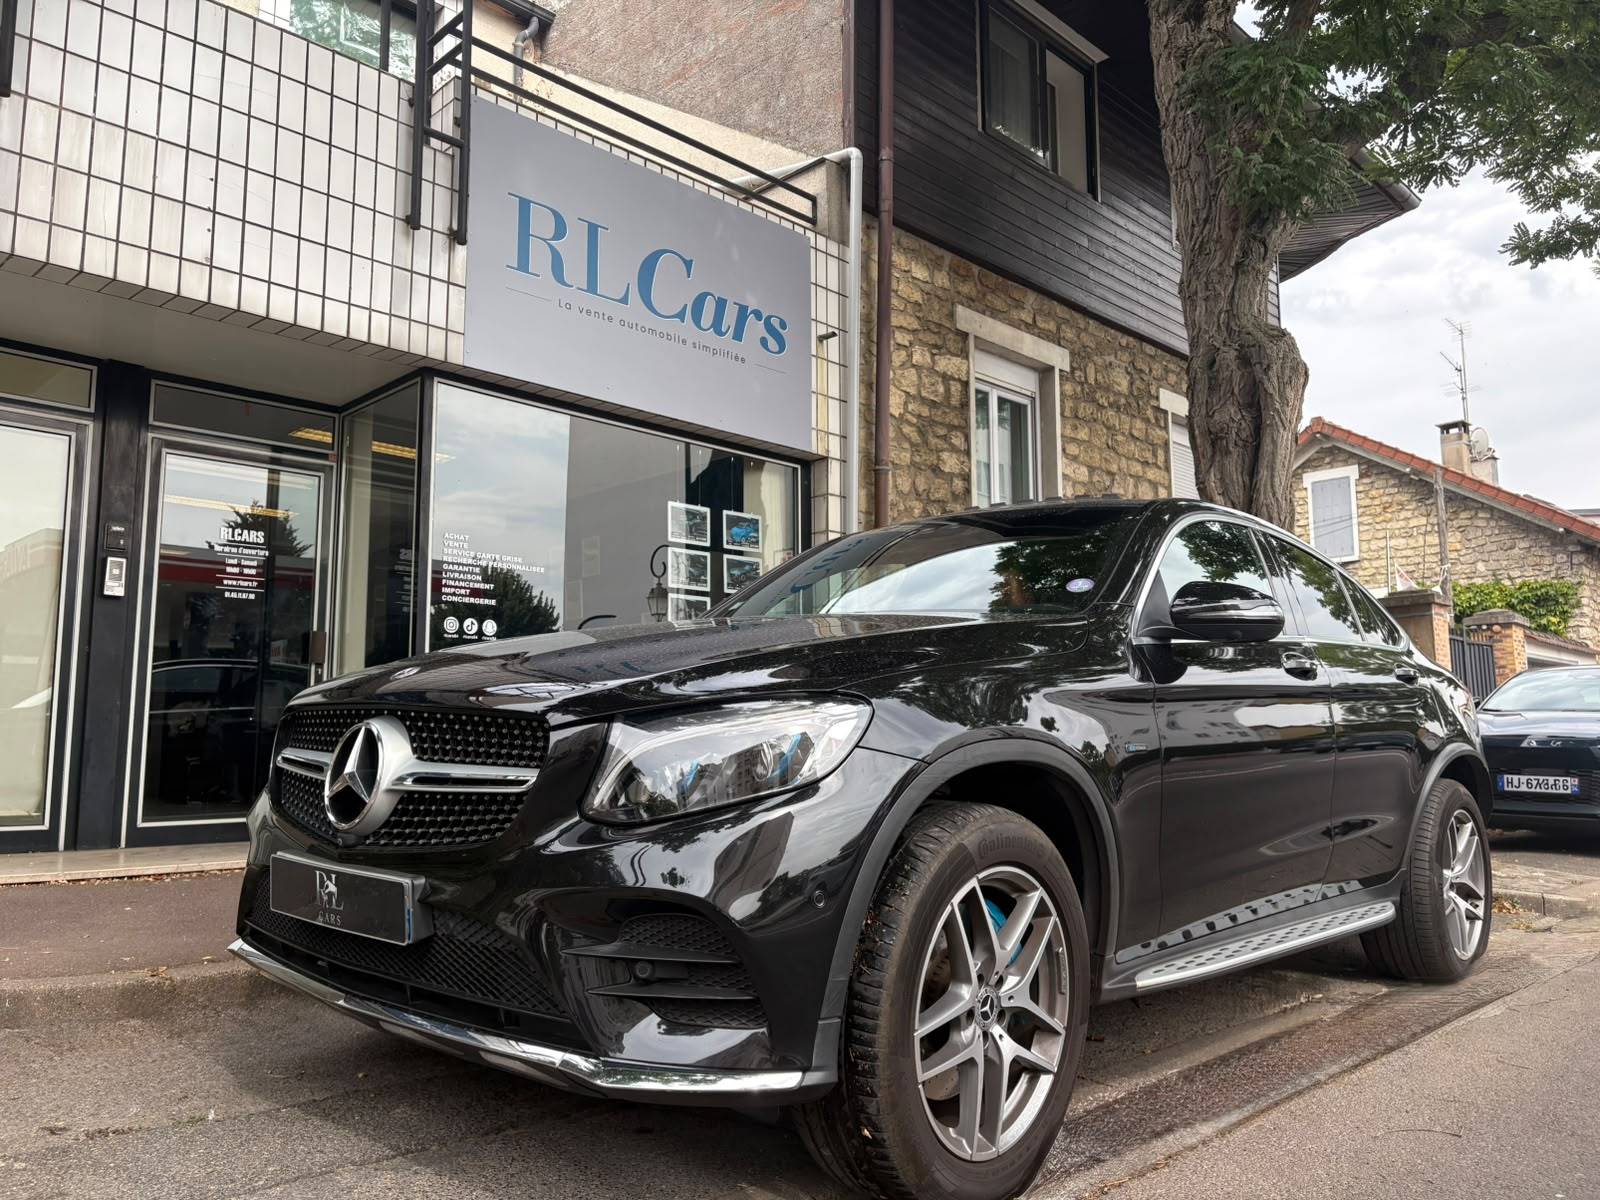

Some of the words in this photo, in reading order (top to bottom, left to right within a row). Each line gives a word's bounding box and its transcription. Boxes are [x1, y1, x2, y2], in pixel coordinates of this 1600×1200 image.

[505, 192, 790, 356] RLCars
[557, 299, 573, 312] La
[578, 305, 614, 324] vente
[619, 318, 688, 346] automobile
[691, 340, 747, 364] simplifiée
[221, 527, 264, 543] RLCARS
[444, 532, 469, 541] ACHAT
[443, 540, 469, 549] VENTE
[443, 548, 475, 557] SERVICE
[476, 552, 500, 561] CARTE
[501, 554, 523, 563] GRISE
[443, 556, 488, 567] RECHERCHE
[442, 564, 481, 573] GARANTIE
[442, 572, 482, 581] LIVRAISON
[442, 579, 495, 590] FINANCEMENT
[442, 587, 471, 596] IMPORT
[442, 595, 497, 606] CONCIERGERIE
